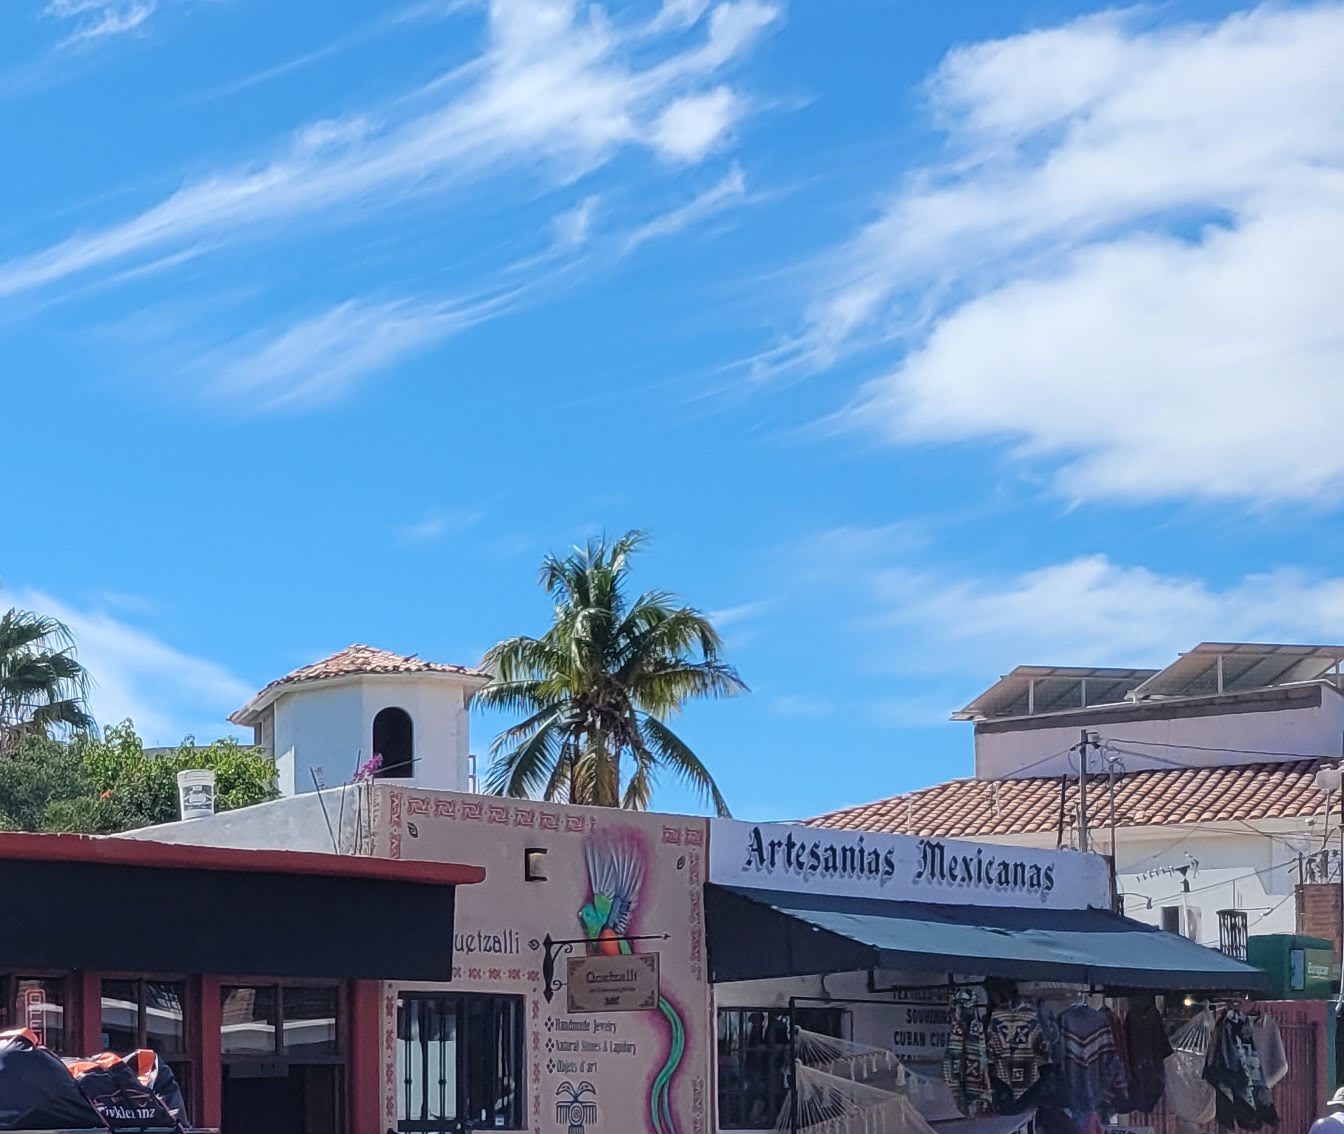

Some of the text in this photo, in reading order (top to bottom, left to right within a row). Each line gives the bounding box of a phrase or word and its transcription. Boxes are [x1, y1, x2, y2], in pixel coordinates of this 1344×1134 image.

[745, 825, 1056, 893] Artesanias Mexicanas
[454, 929, 520, 955] uetzalli
[894, 1031, 926, 1047] CUBAN
